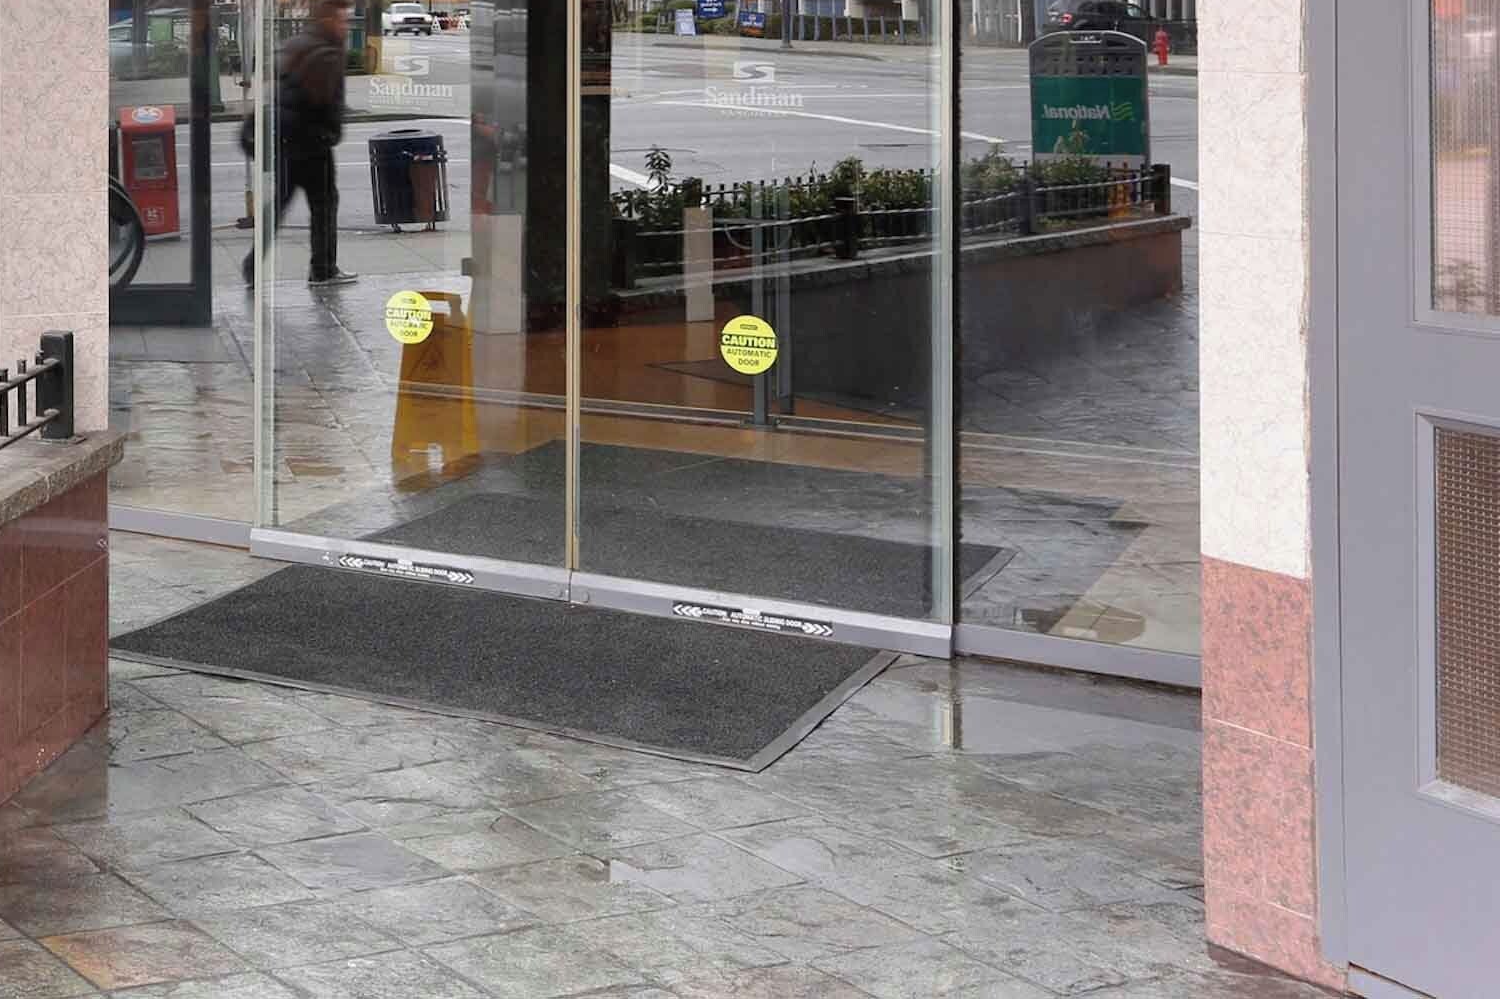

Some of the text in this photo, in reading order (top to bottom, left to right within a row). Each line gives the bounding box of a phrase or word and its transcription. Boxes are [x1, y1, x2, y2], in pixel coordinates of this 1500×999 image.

[369, 77, 452, 97] Sandman
[707, 86, 804, 106] Sandman
[722, 334, 776, 348] CAUTION
[727, 348, 771, 358] AUTOMATIC
[739, 358, 759, 366] DOOR
